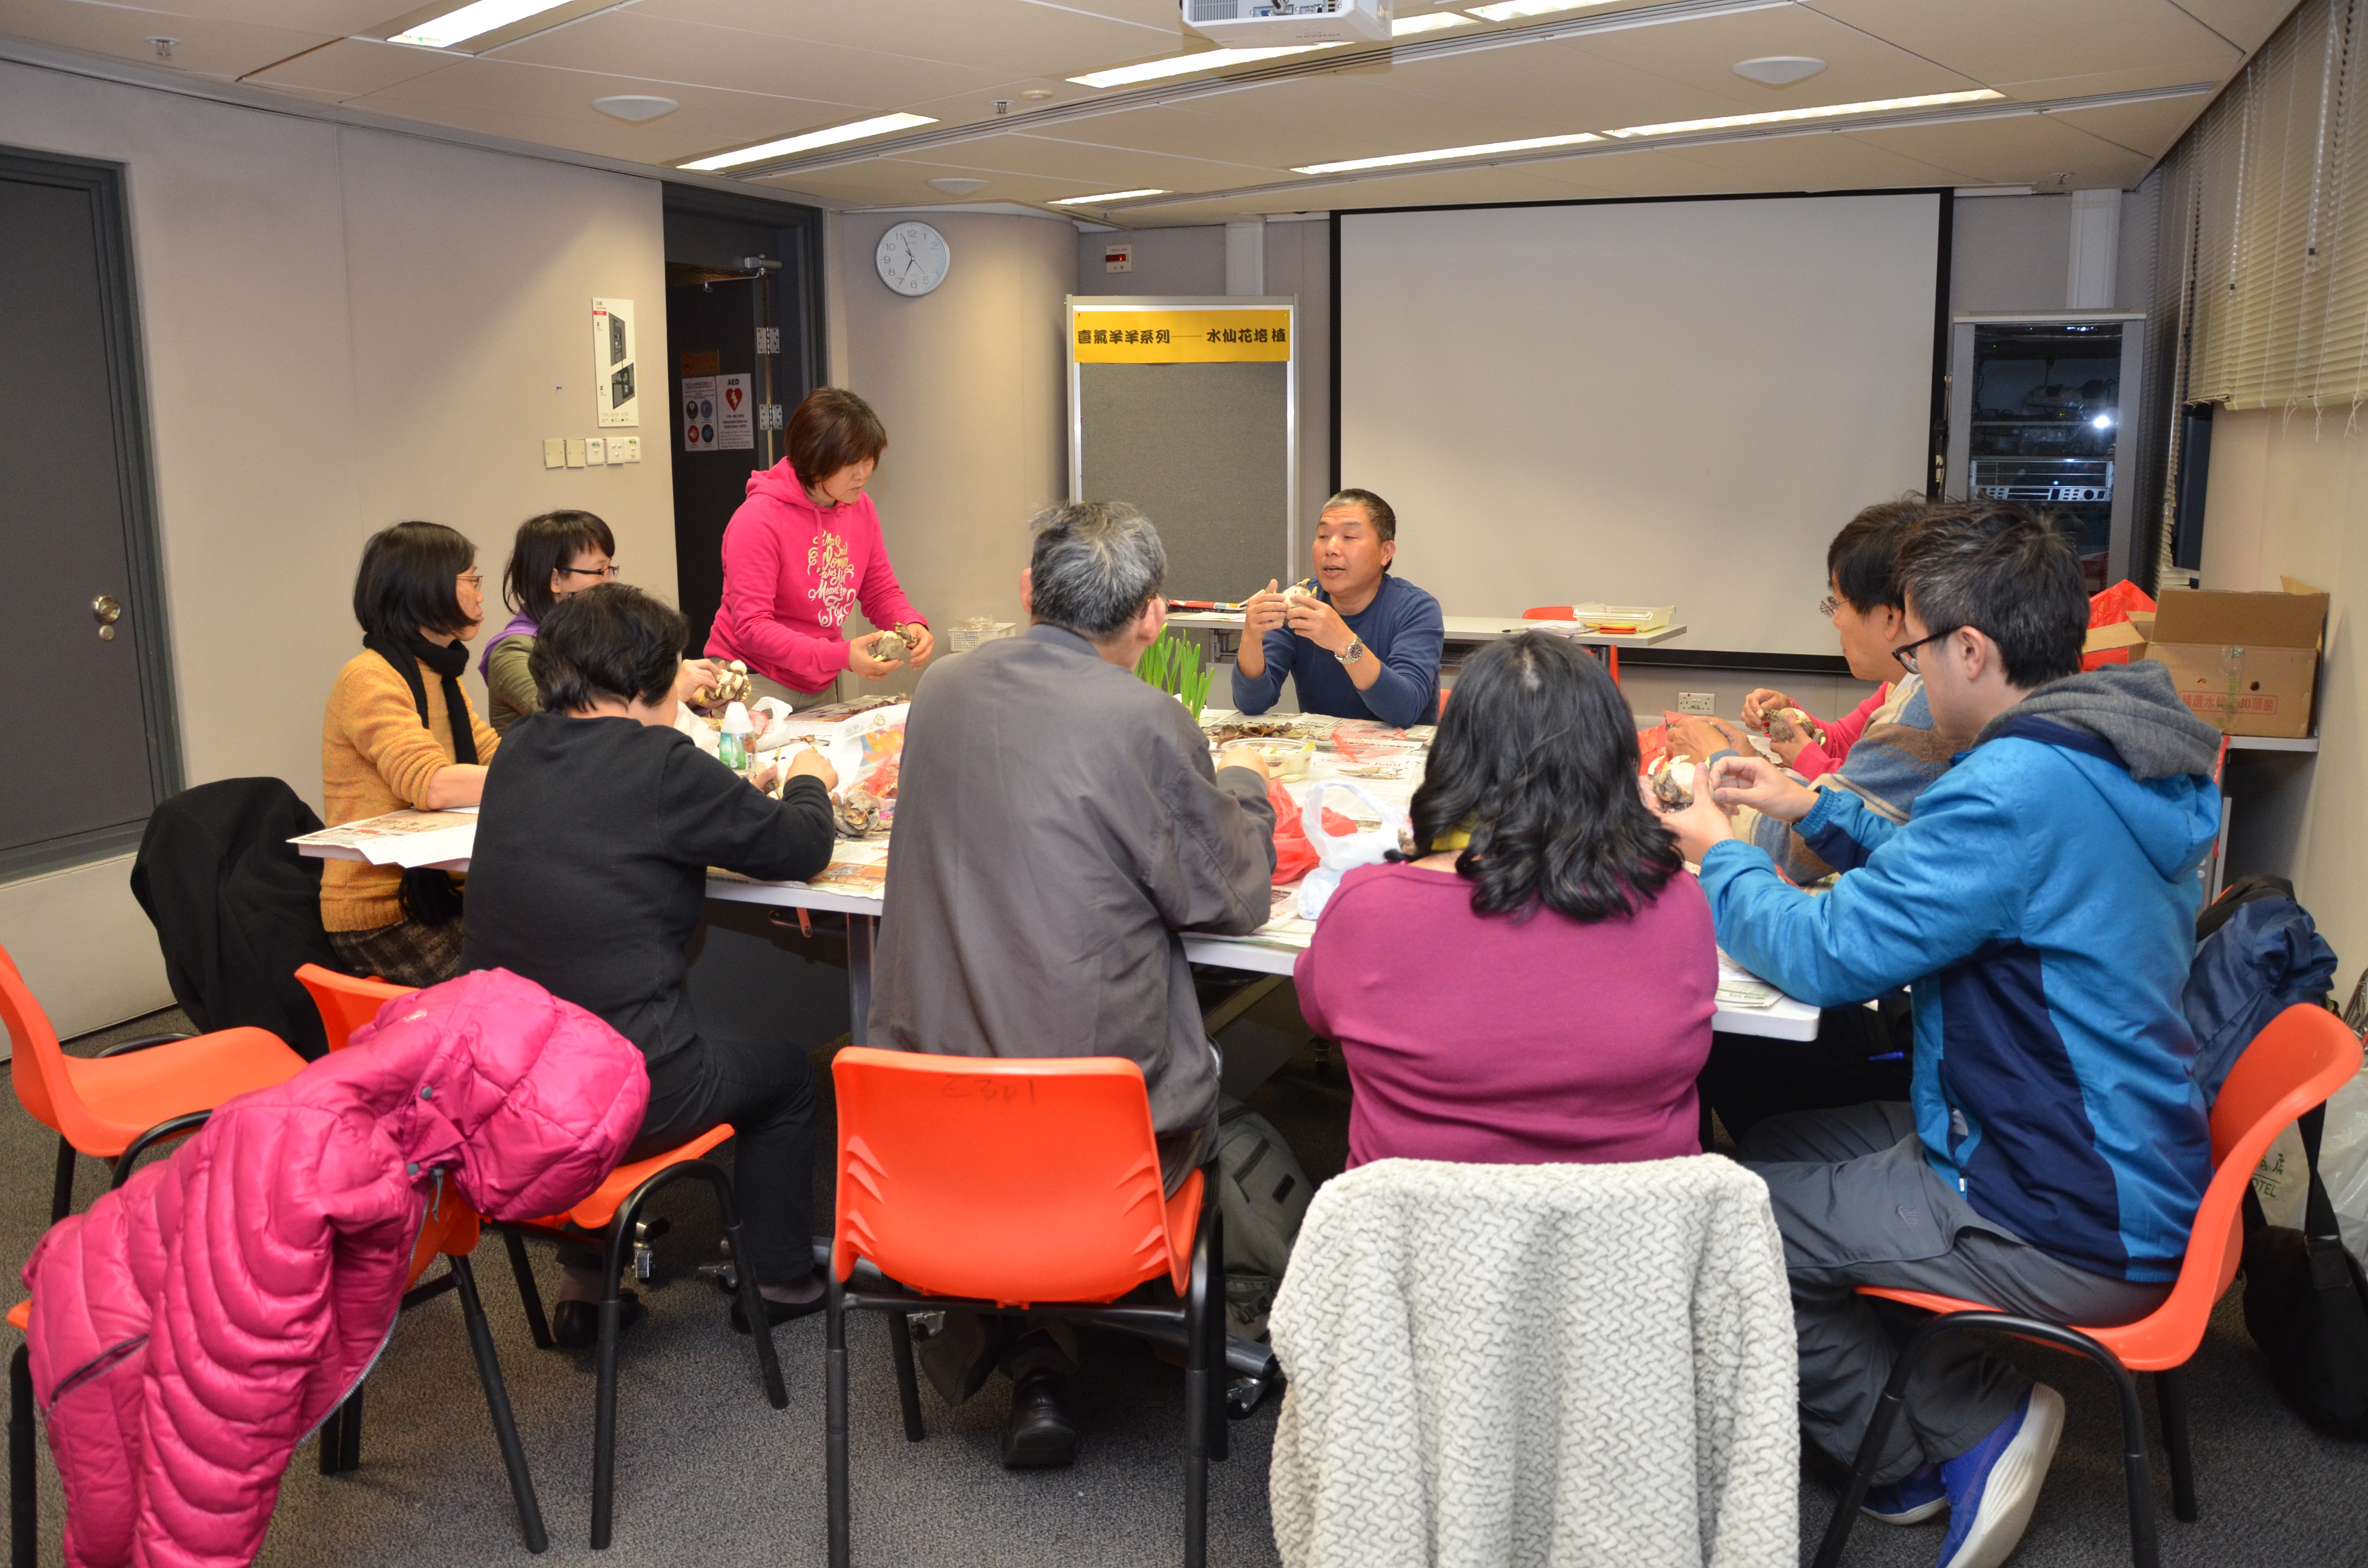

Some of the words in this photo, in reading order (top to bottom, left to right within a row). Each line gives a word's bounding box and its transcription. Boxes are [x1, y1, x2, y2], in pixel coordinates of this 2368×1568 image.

[886, 243, 895, 251] 10
[883, 256, 890, 264] 9
[897, 277, 904, 285] 7
[911, 280, 917, 288] 6
[923, 276, 929, 284] 5
[1207, 328, 1286, 343] 水仙花培植
[2253, 1177, 2276, 1198] OTEL
